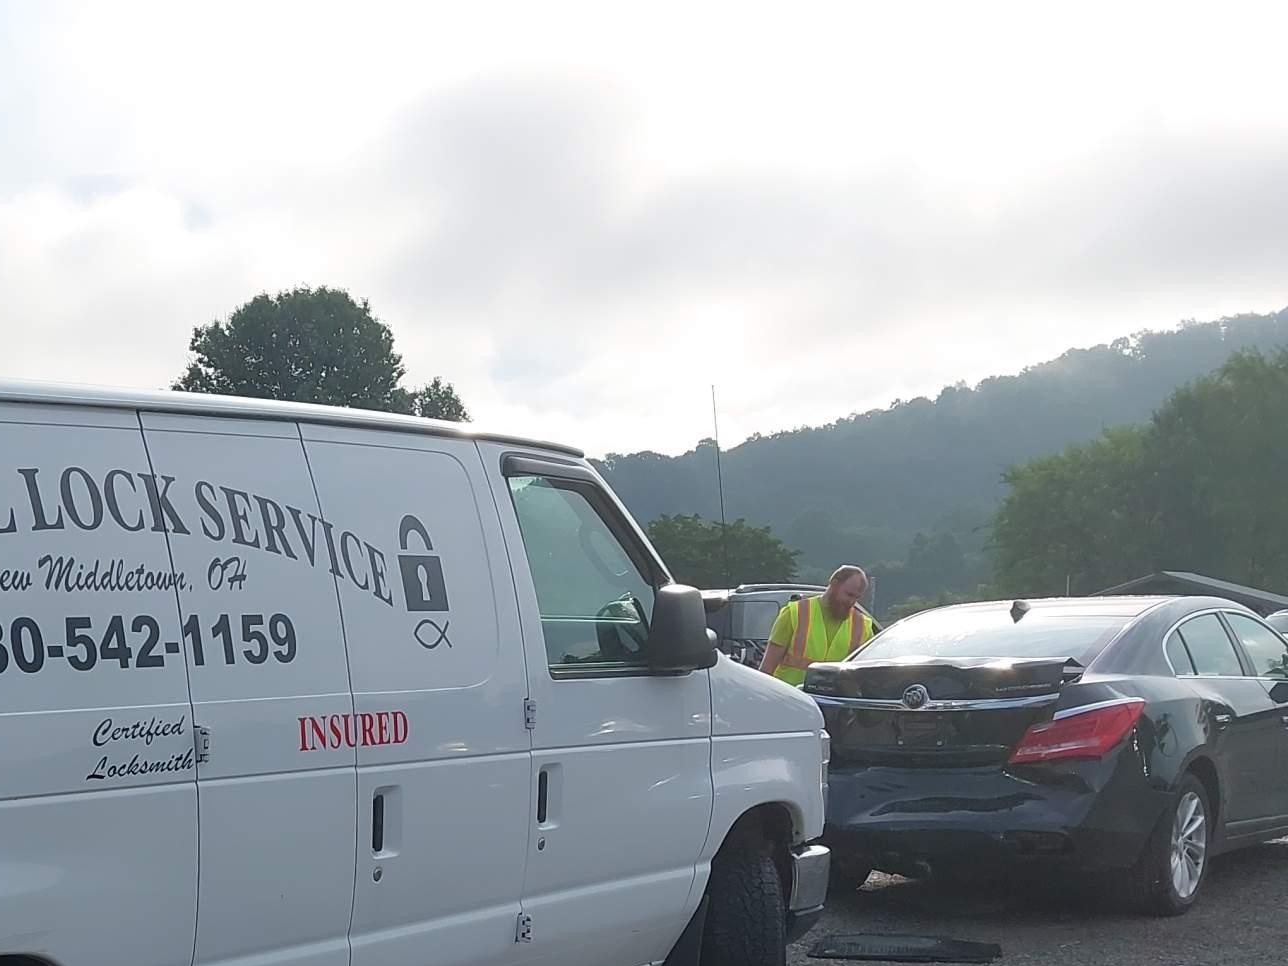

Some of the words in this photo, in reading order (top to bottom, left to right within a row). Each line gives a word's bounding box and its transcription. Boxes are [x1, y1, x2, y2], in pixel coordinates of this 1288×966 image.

[17, 466, 192, 536] LOCK
[194, 480, 394, 608] SERVICE
[207, 557, 248, 592] OH
[92, 715, 185, 748] Certified
[298, 711, 409, 752] INSURED
[86, 749, 194, 782] Locksmith
